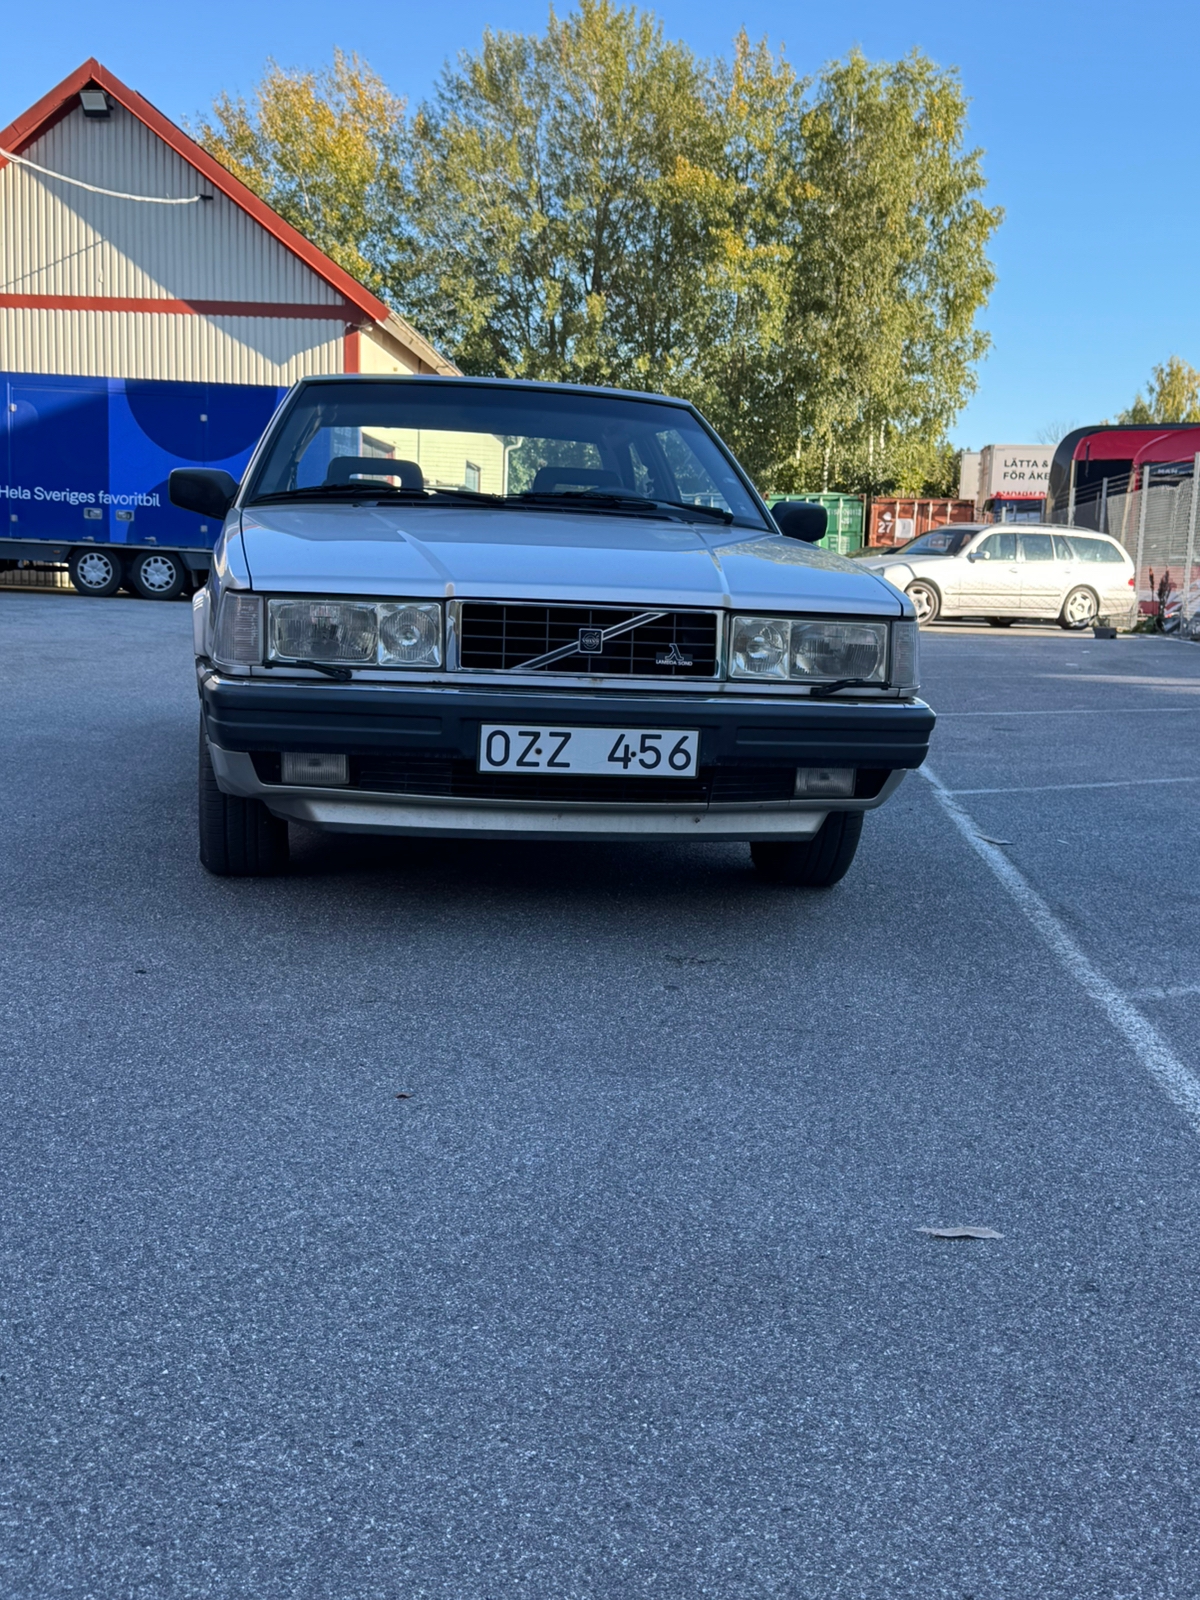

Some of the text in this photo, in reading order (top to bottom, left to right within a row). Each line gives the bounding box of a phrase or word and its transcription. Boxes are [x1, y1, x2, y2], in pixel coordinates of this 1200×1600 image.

[1004, 457, 1049, 468] LÄTTA &
[1003, 470, 1025, 480] FÖR
[0, 485, 161, 508] Hela Sveriges favoritbil
[877, 522, 893, 534] 27
[485, 729, 692, 771] OZZ 456
